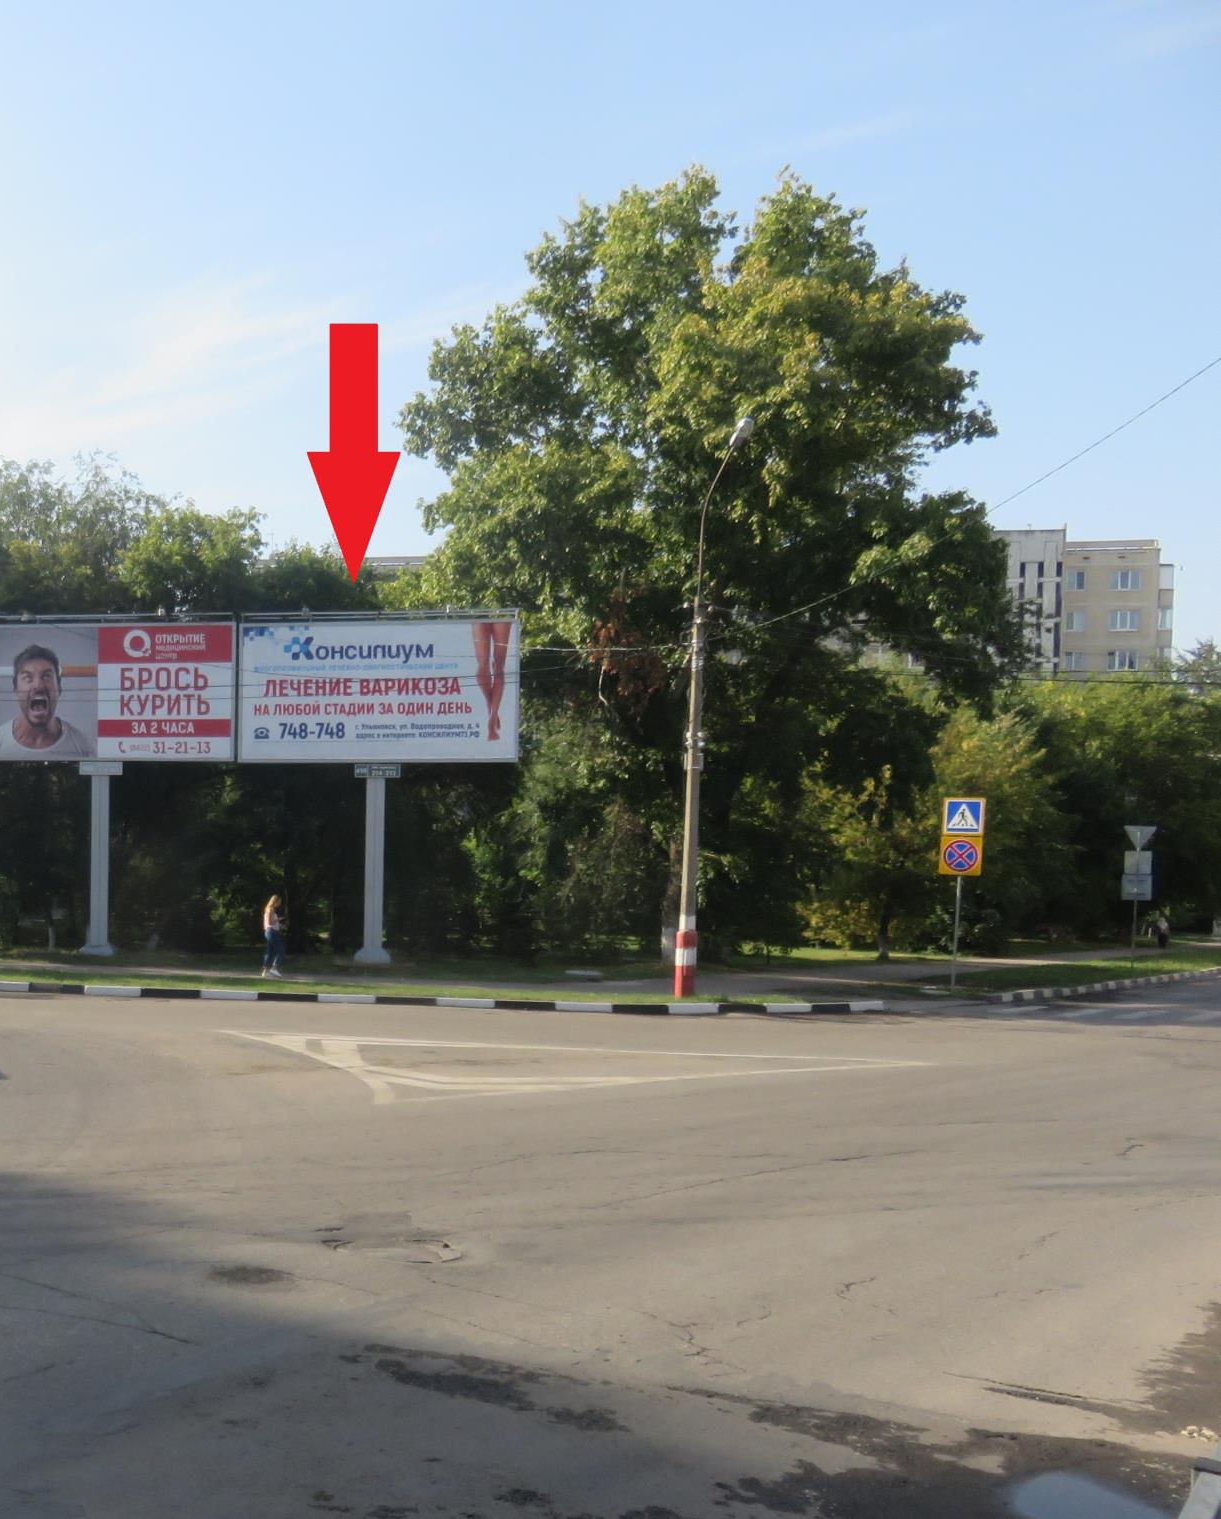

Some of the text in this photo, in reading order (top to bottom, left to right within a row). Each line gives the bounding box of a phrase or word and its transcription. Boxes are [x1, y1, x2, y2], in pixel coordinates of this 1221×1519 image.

[155, 634, 206, 644] ОТКРЫТИЕ
[120, 667, 209, 692] БРОСЬ
[263, 676, 461, 698] ЛЕЧЕНИЕ ВАРИКОЗА
[120, 694, 211, 716] КУРИТЬ
[254, 701, 472, 717] НА ЛЮБОЙ СТАДИИ ЗА ОДИН ДЕНЬ
[131, 722, 195, 734] ЗА 2 ЧАСА
[279, 722, 345, 740] 748-748
[153, 741, 211, 754] 31-21-13
